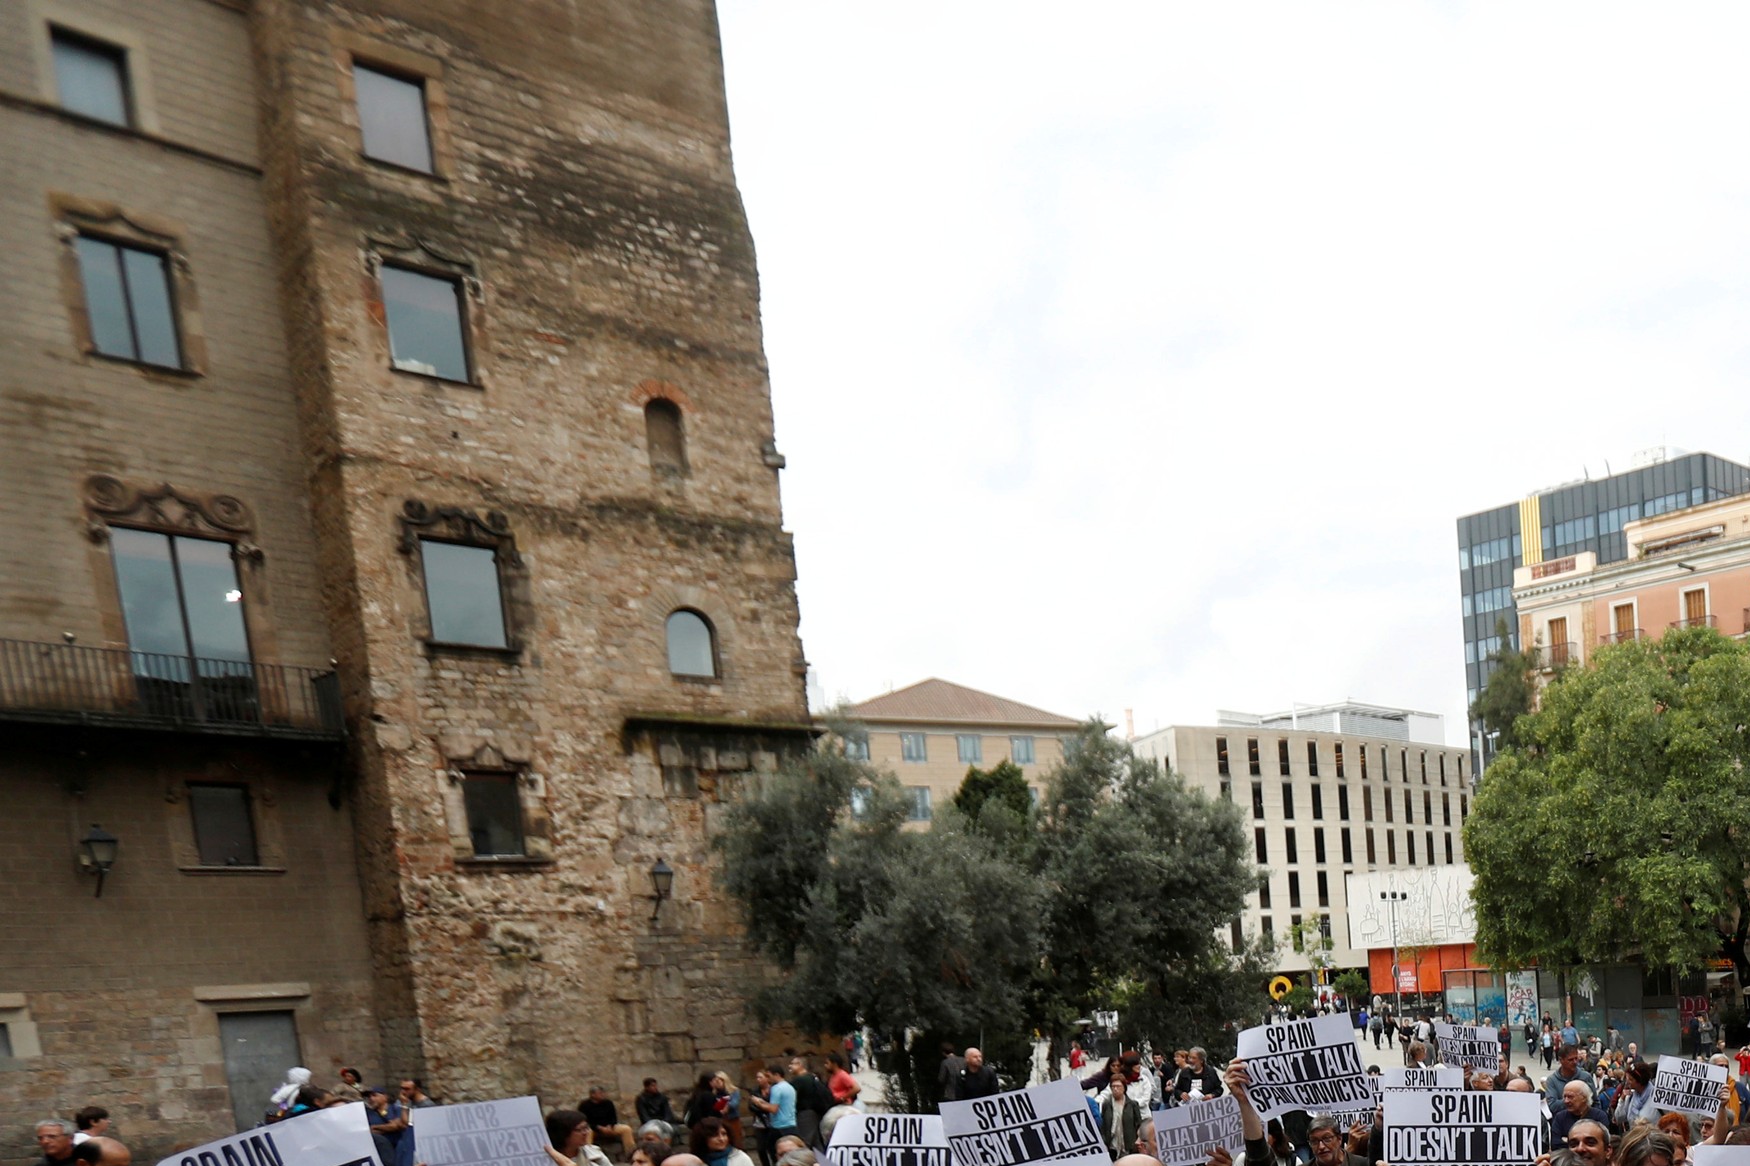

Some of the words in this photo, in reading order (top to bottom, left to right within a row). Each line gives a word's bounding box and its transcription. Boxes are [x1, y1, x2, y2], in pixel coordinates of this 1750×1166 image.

[1266, 1022, 1316, 1053] SPAIN
[1440, 1038, 1470, 1055] DOESN'T
[1473, 1041, 1497, 1057] TALK
[1452, 1026, 1477, 1040] SPAIN
[1311, 1042, 1361, 1078] TALK
[1680, 1060, 1708, 1079] SPAIN
[1405, 1070, 1437, 1087] SPAIN
[1658, 1072, 1699, 1094] DOESN'T
[1250, 1086, 1298, 1113] SPAIN
[1295, 1076, 1370, 1106] CONVICTS
[1431, 1094, 1493, 1124] SPAIN
[1653, 1089, 1680, 1106] SPAIN
[1680, 1094, 1719, 1113] CONVICTS
[972, 1092, 1037, 1130] SPAIN
[864, 1116, 923, 1144] SPAIN
[1032, 1112, 1097, 1153] TALK
[1389, 1127, 1475, 1162] DOESN'T
[1483, 1126, 1537, 1161] TALK
